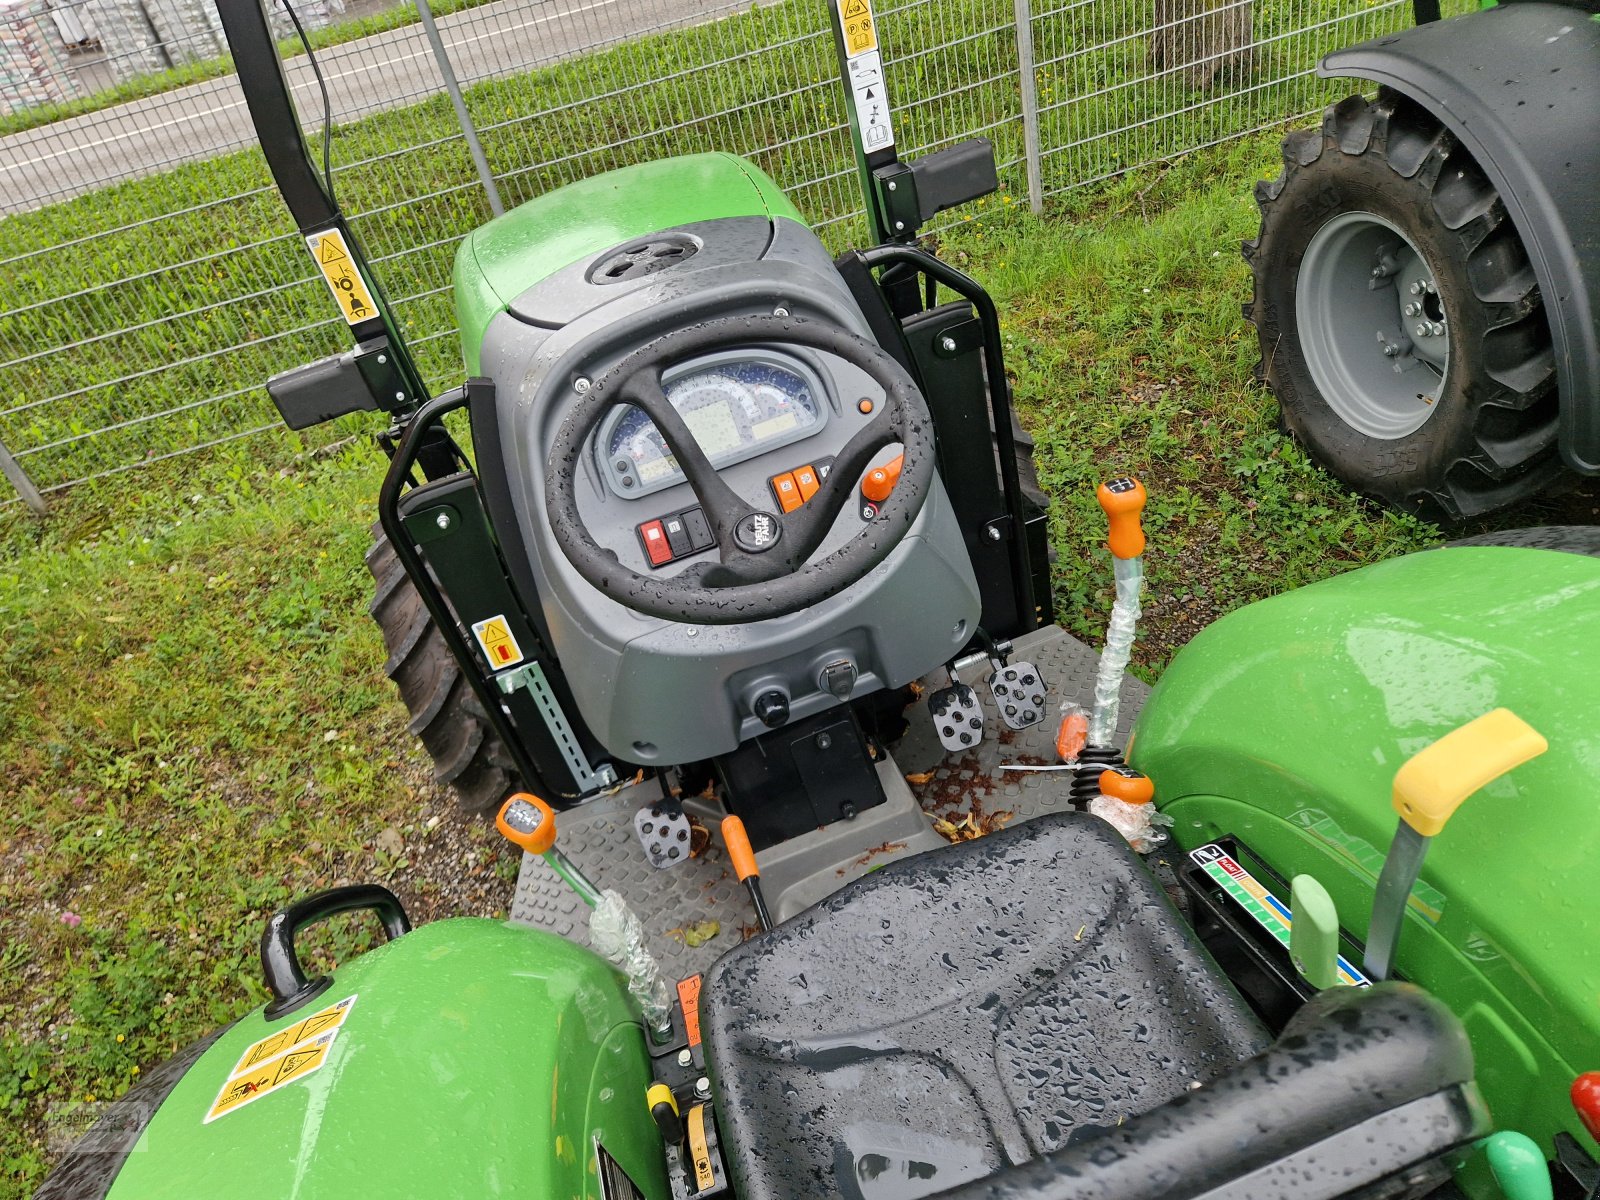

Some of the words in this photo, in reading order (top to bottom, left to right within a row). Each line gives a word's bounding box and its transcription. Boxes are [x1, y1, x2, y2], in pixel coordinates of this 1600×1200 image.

[754, 514, 763, 546] DEUTZ
[761, 516, 770, 542] FAHR
[1219, 858, 1238, 873] FLOAT
[699, 1172, 711, 1181] 540
